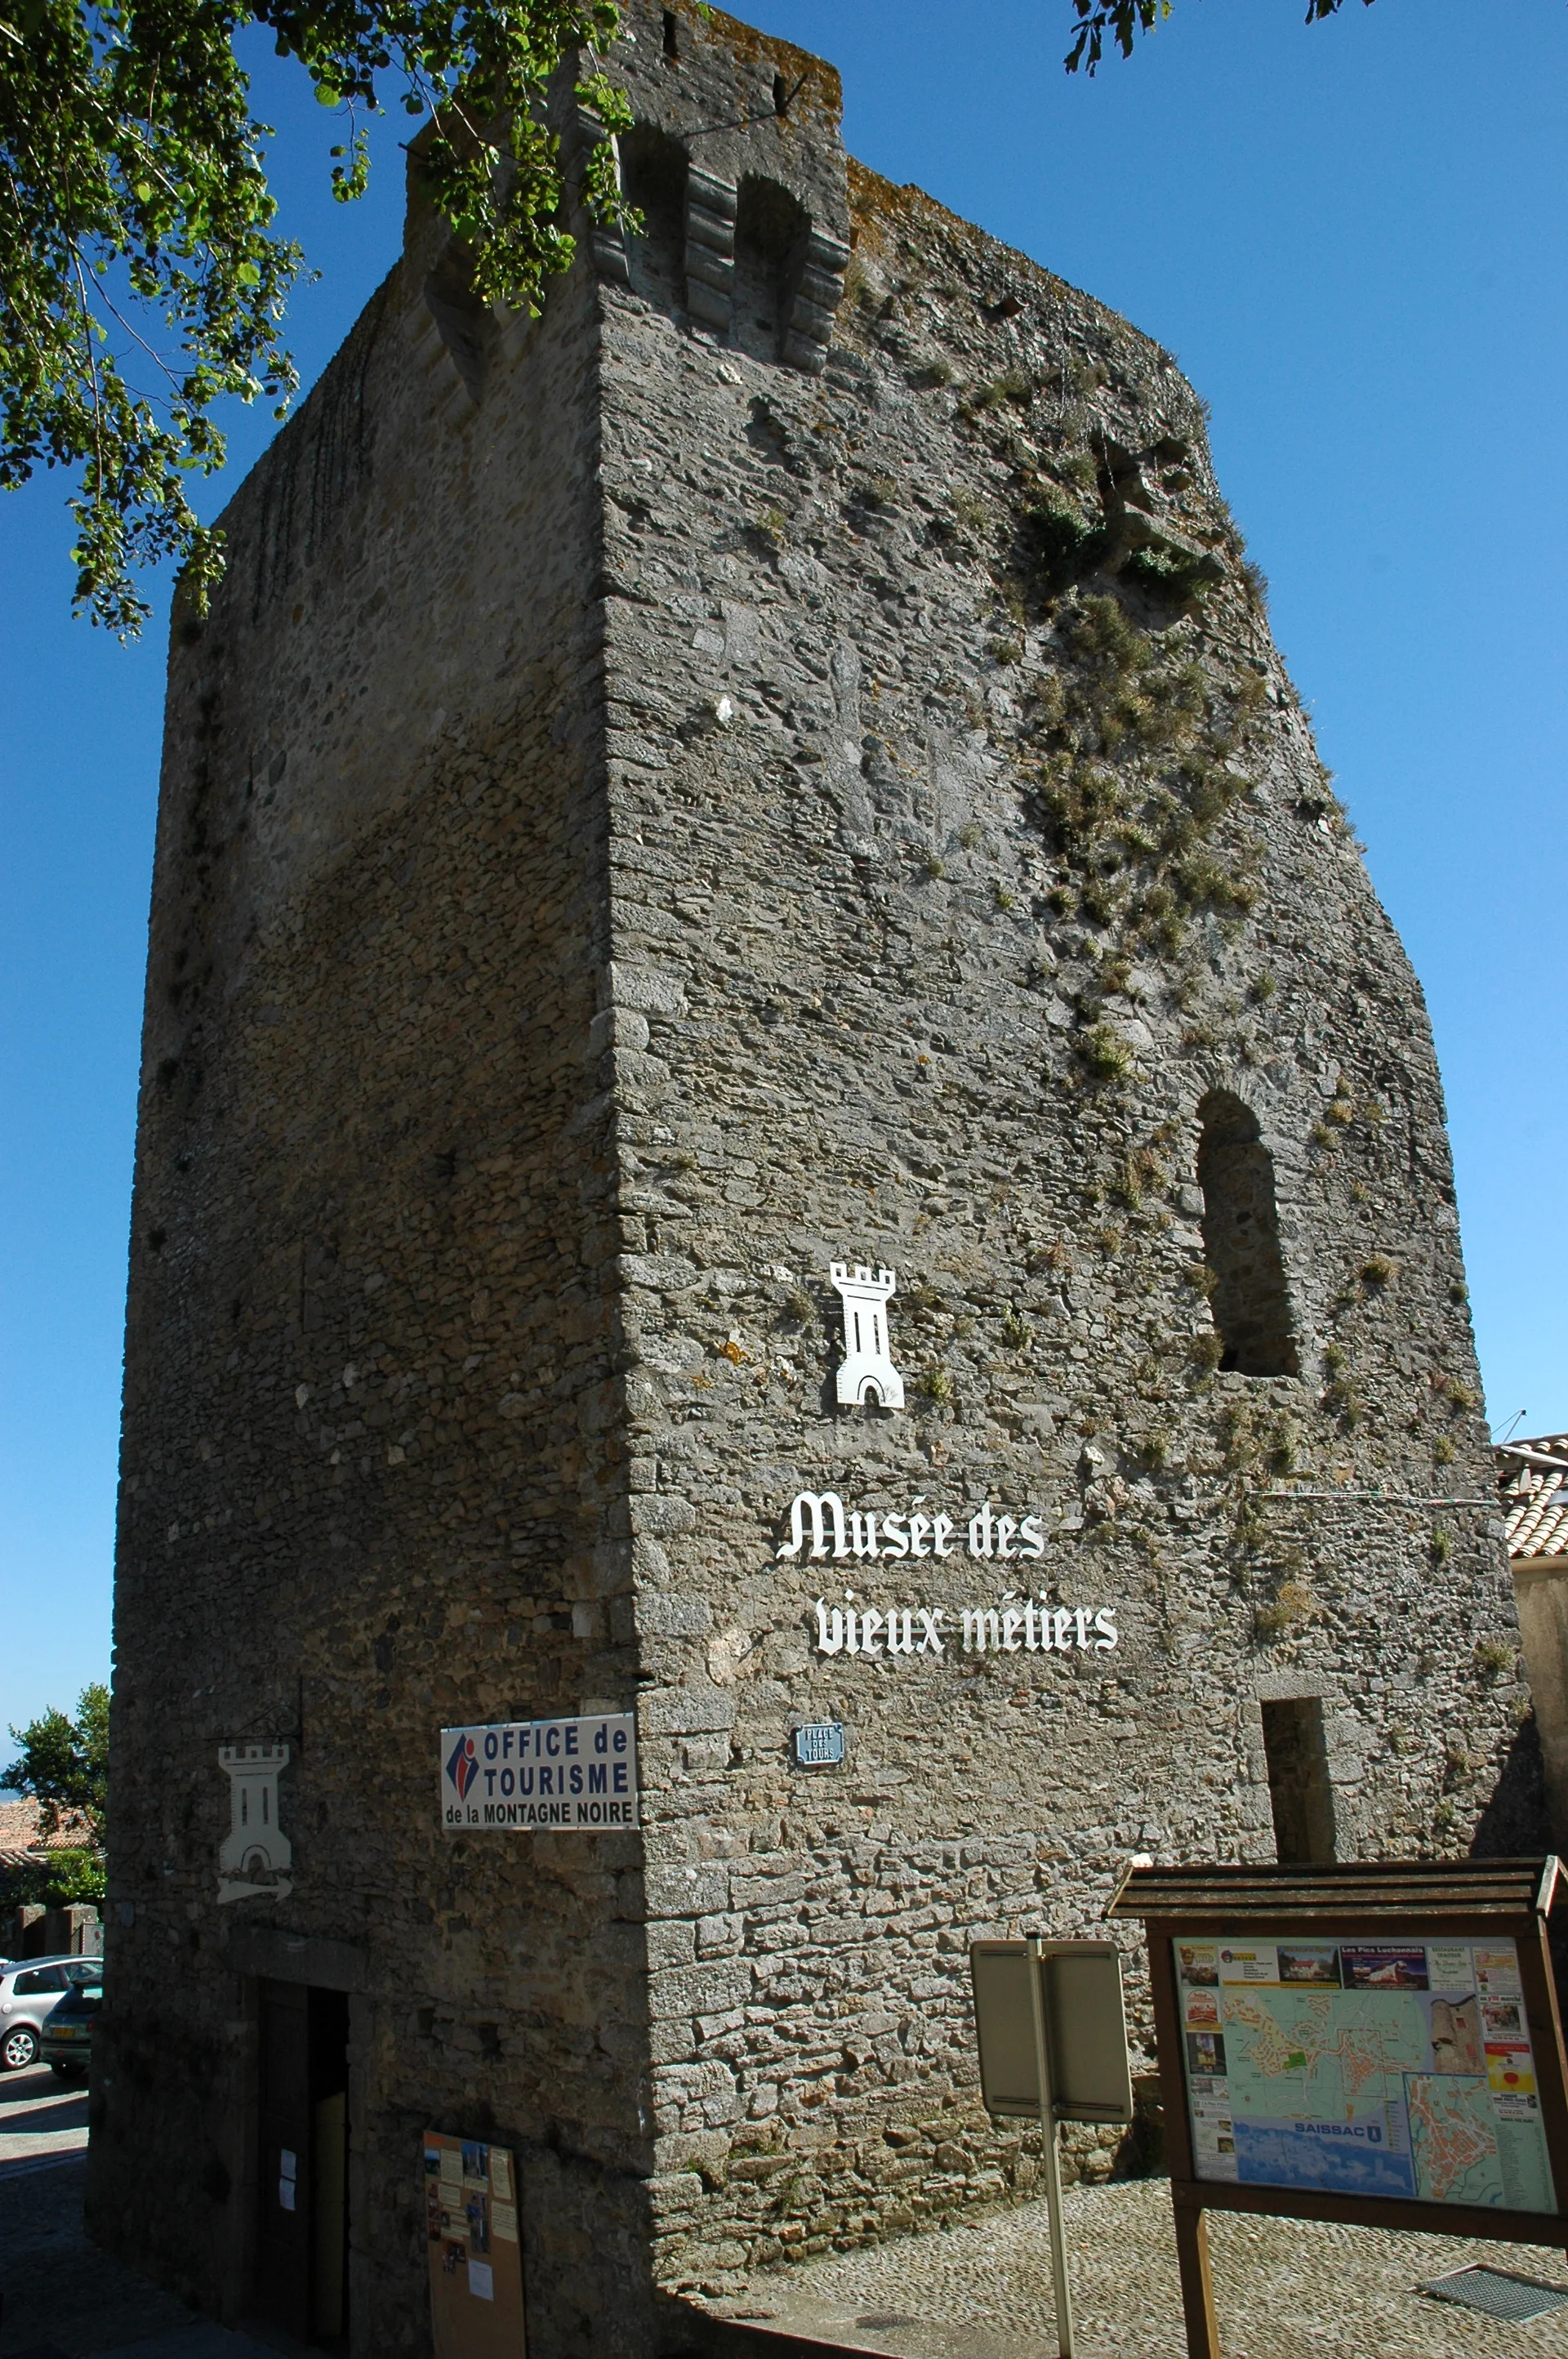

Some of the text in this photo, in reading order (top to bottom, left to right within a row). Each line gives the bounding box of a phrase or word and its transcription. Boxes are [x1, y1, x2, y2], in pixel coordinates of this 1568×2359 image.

[776, 1491, 1045, 1559] Musée des
[815, 1590, 1118, 1655] vieux métiers
[484, 1723, 627, 1760] OFFICE de
[805, 1727, 833, 1741] PLACE
[812, 1739, 827, 1749] DES
[806, 1748, 835, 1761] TOURS
[484, 1762, 629, 1796] TOURISME
[446, 1801, 633, 1823] de la MONTAGNE NOIRE
[1294, 2122, 1365, 2137] SAISSAC
